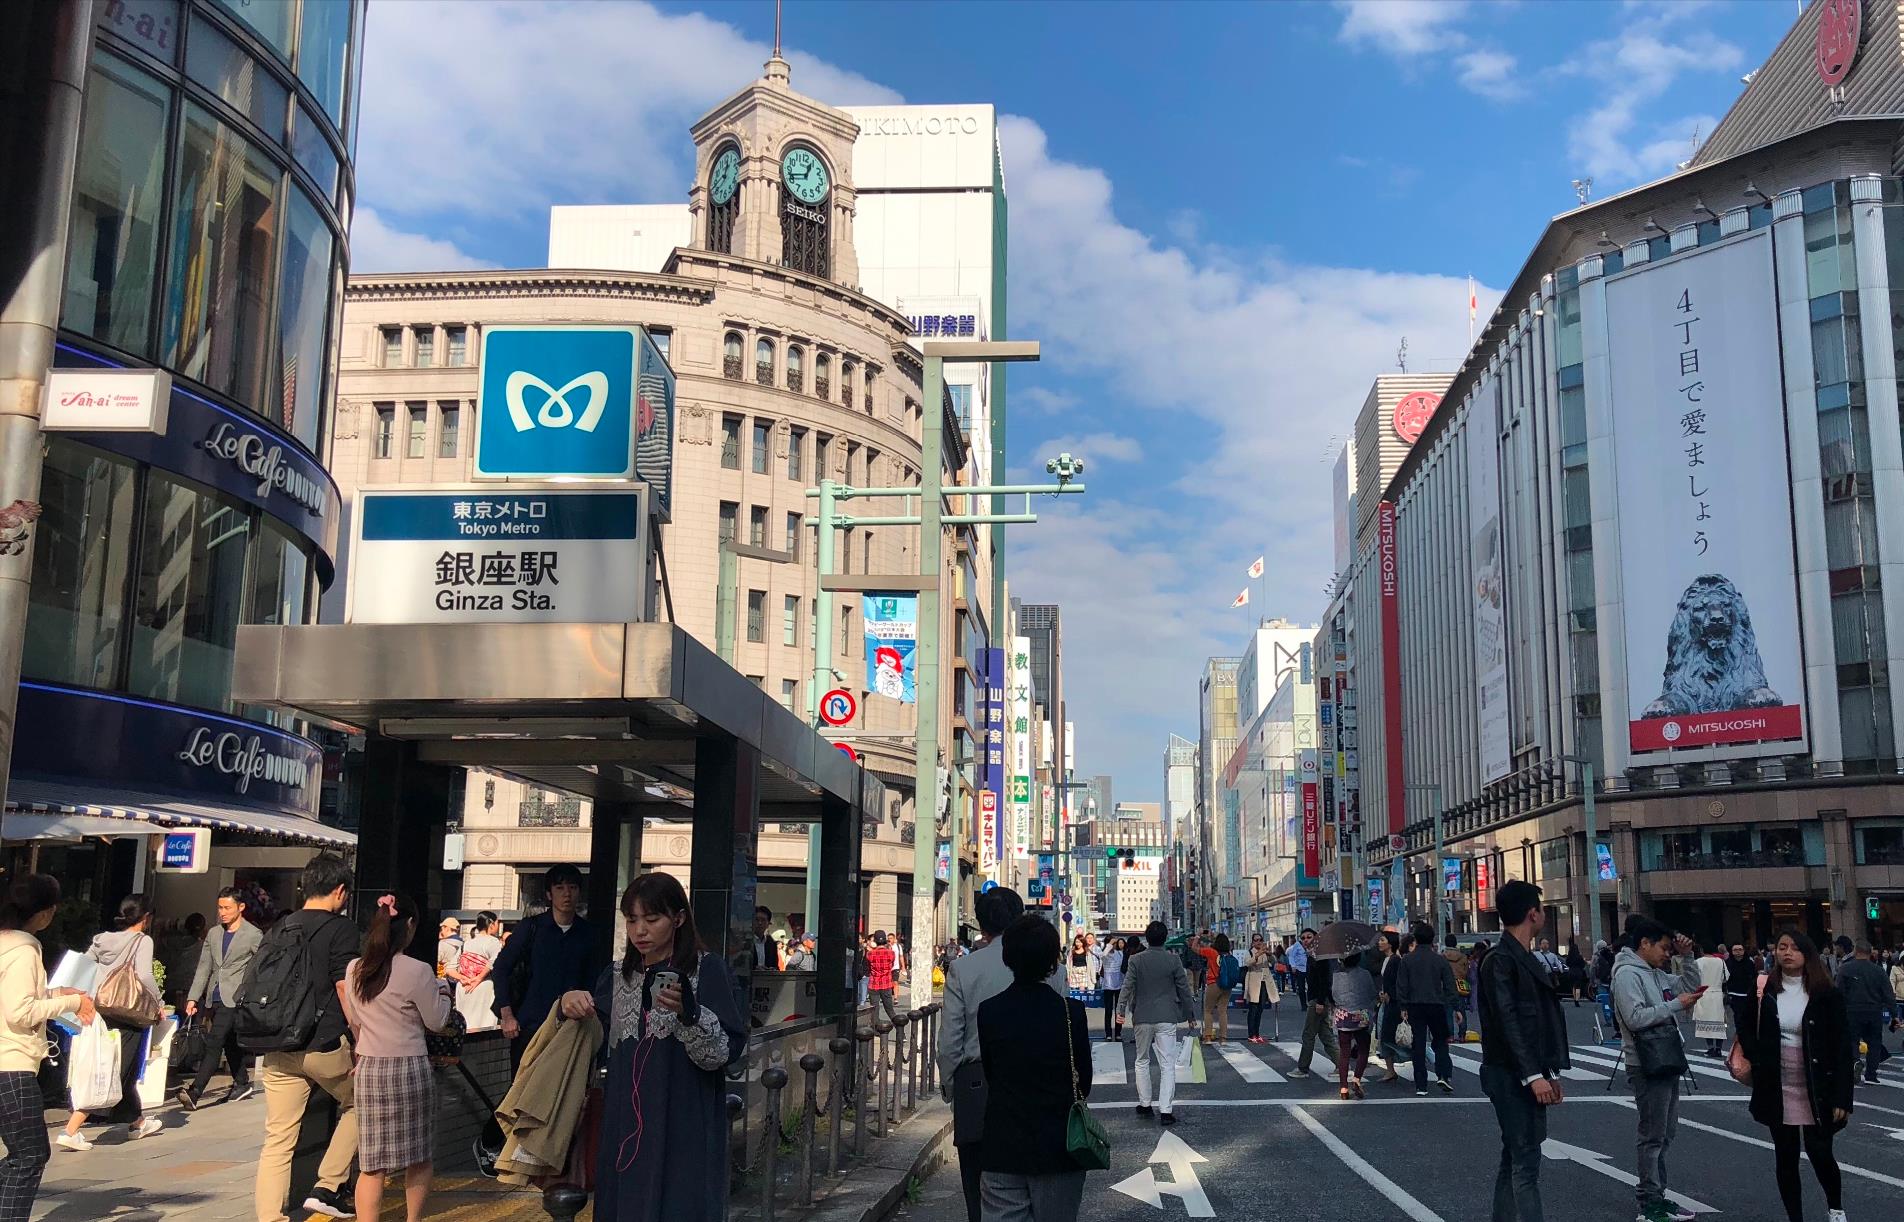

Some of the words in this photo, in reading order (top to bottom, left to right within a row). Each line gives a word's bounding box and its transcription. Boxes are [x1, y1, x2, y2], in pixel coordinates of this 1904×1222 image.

[858, 116, 978, 136] IKIMOTO
[786, 202, 826, 224] SEIKO
[1673, 287, 1712, 557] 4丁目で愛ましょう
[205, 422, 238, 459] Le
[240, 434, 287, 498] Café
[453, 501, 547, 519] 東京メトロ
[458, 522, 497, 536] Tokyo
[500, 522, 540, 534] Metro
[1382, 509, 1394, 596] MITSUKOSHI
[435, 550, 560, 586] 銀座駅
[435, 589, 503, 610] Ginza
[511, 589, 556, 610] Sta.
[1014, 652, 1029, 734] 教文館
[989, 687, 1002, 765] 山野楽器
[1688, 718, 1766, 734] MITSUKOSHI
[180, 727, 215, 766] Le
[217, 732, 266, 794] Café
[1014, 779, 1028, 799] 本
[983, 813, 995, 868] キムラヤのパン
[1121, 860, 1152, 871] LXIL
